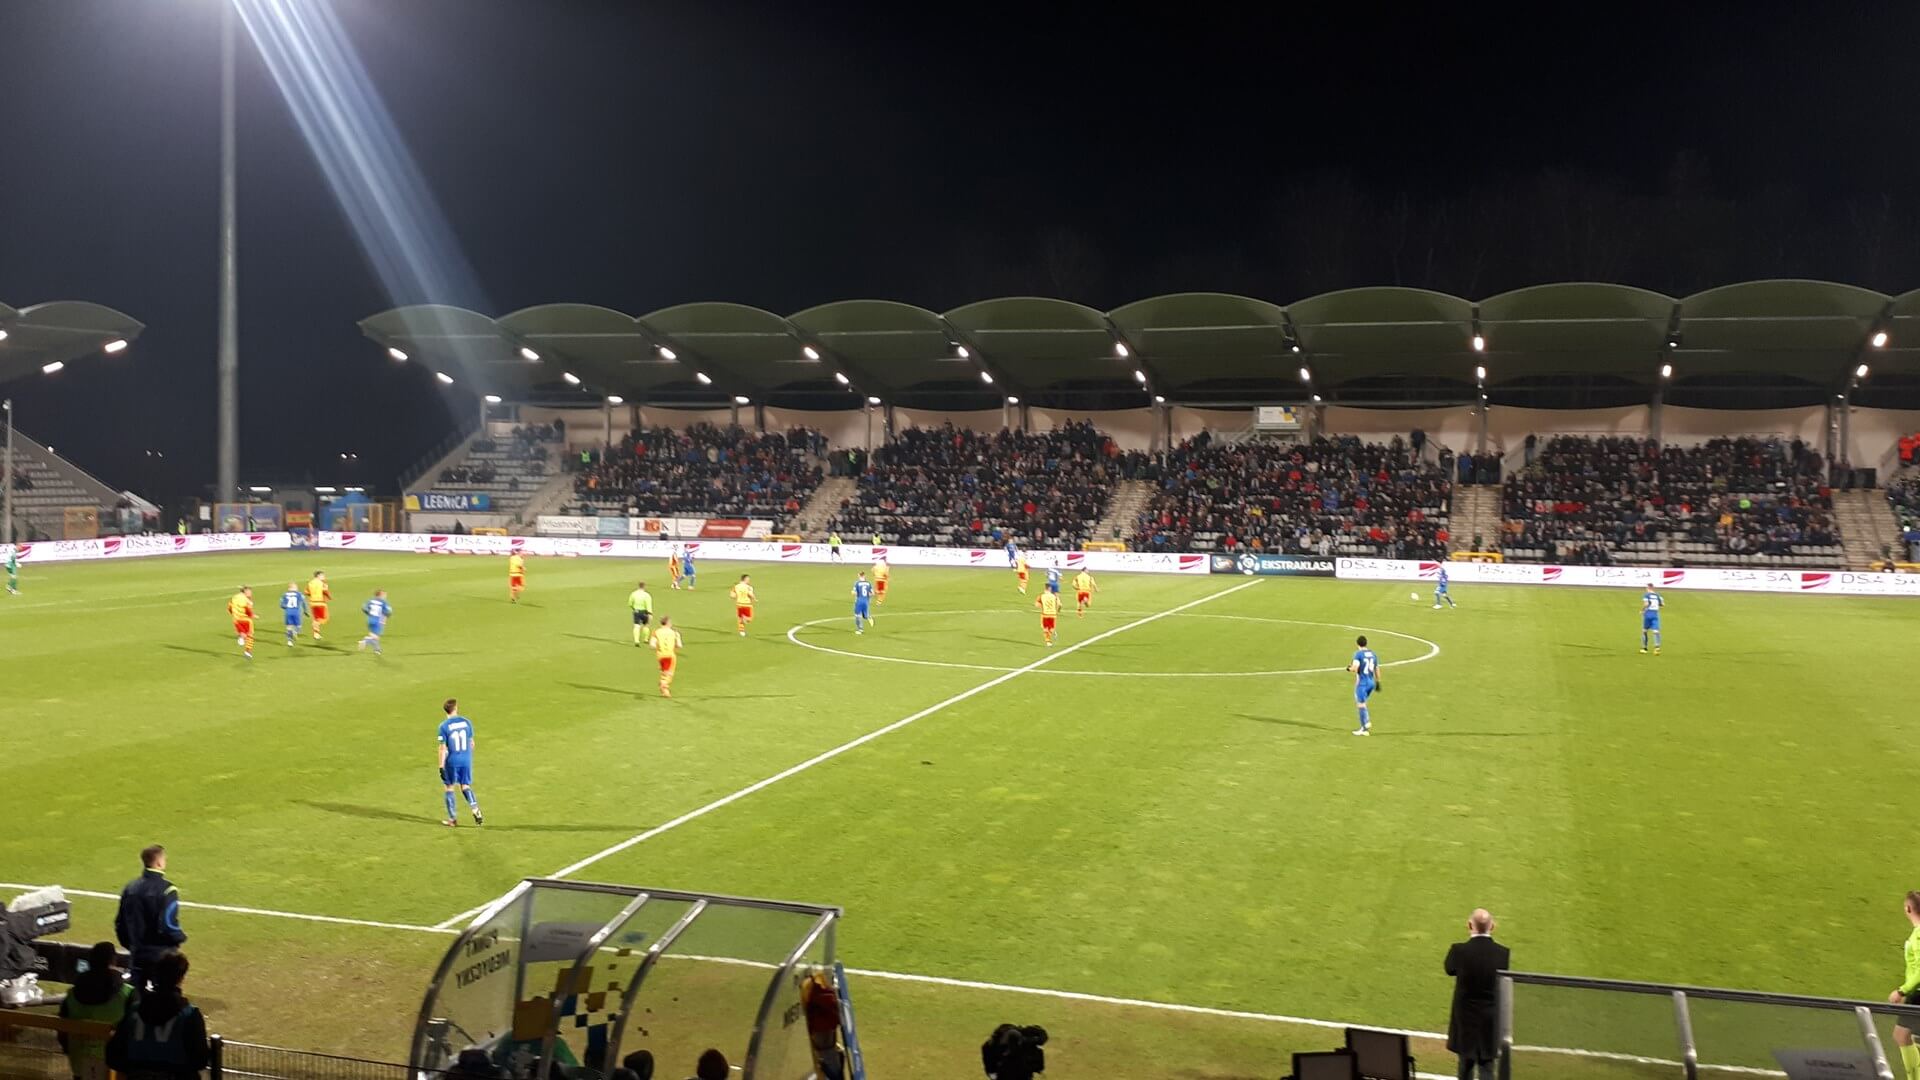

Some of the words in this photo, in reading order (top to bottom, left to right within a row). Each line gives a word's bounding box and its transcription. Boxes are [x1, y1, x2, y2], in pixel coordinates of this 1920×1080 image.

[424, 494, 469, 509] LEGNICA
[1262, 559, 1335, 572] EKSTRAKLASA
[451, 729, 467, 752] 11
